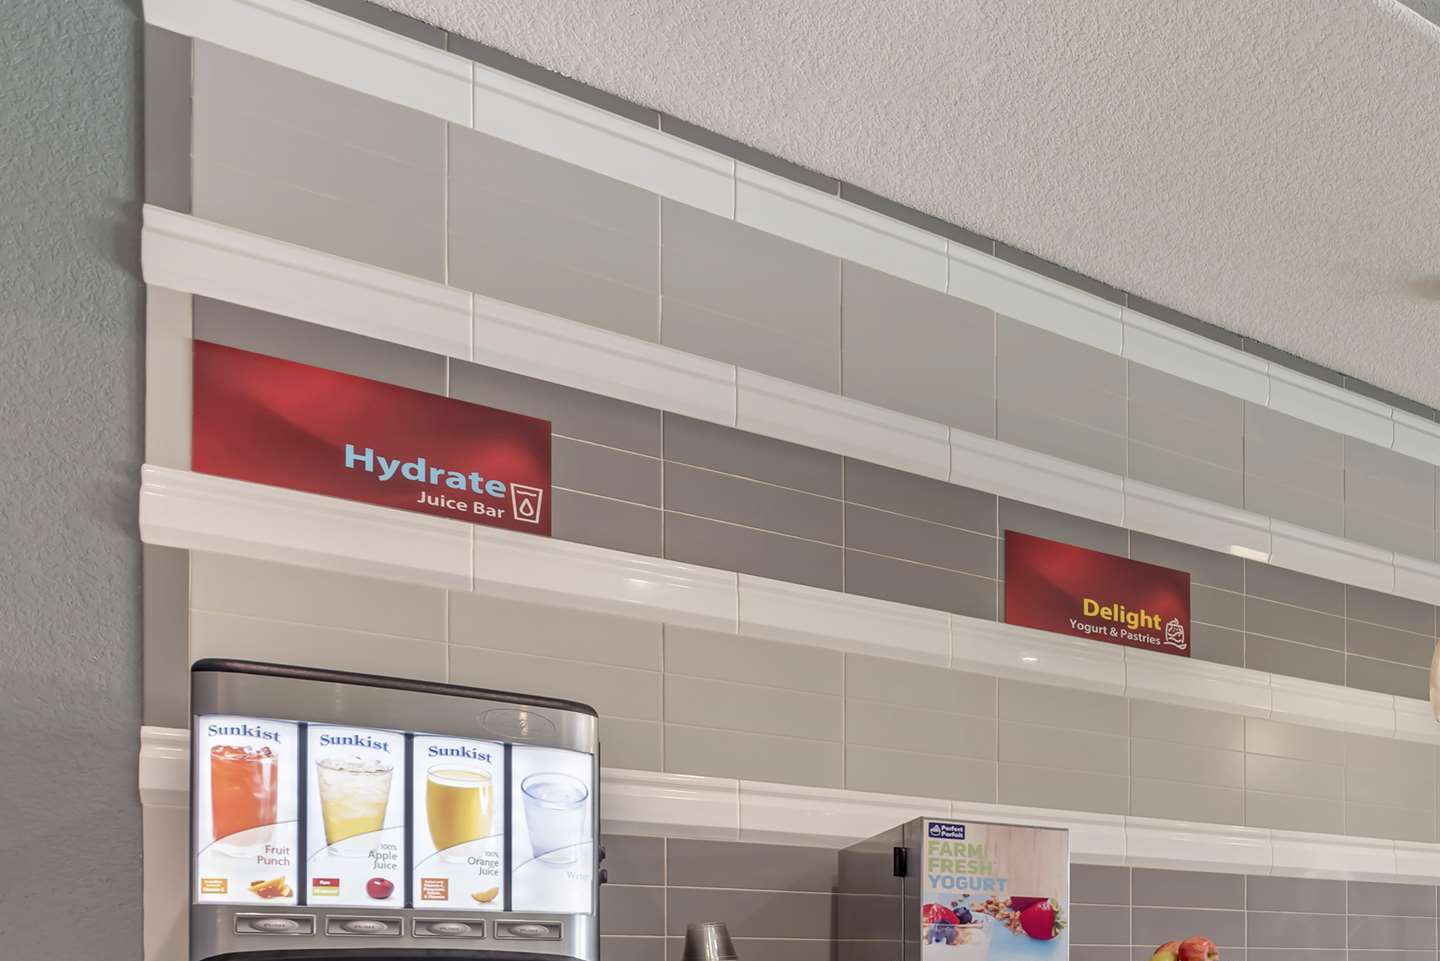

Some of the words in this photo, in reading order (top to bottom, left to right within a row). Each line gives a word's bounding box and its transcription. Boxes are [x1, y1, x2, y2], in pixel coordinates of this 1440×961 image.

[345, 444, 507, 498] Hydrate
[416, 491, 468, 513] Juice
[473, 502, 505, 519] Bar
[1083, 598, 1161, 630] Delight
[1069, 618, 1108, 636] Yogurt
[1109, 626, 1119, 638] &
[1120, 630, 1161, 646] Pastries
[208, 723, 282, 744] Sunkist
[319, 734, 391, 753] Sunkist
[427, 745, 493, 765] Sunkist
[265, 844, 290, 856] Fruit
[367, 850, 398, 861] Apple
[928, 841, 983, 858] FARM
[257, 855, 290, 866] Punch
[373, 860, 398, 870] Juice
[467, 856, 499, 868] Orange
[928, 858, 993, 875] FRESH
[478, 866, 499, 875] Juice
[928, 874, 1009, 892] YOGURT
